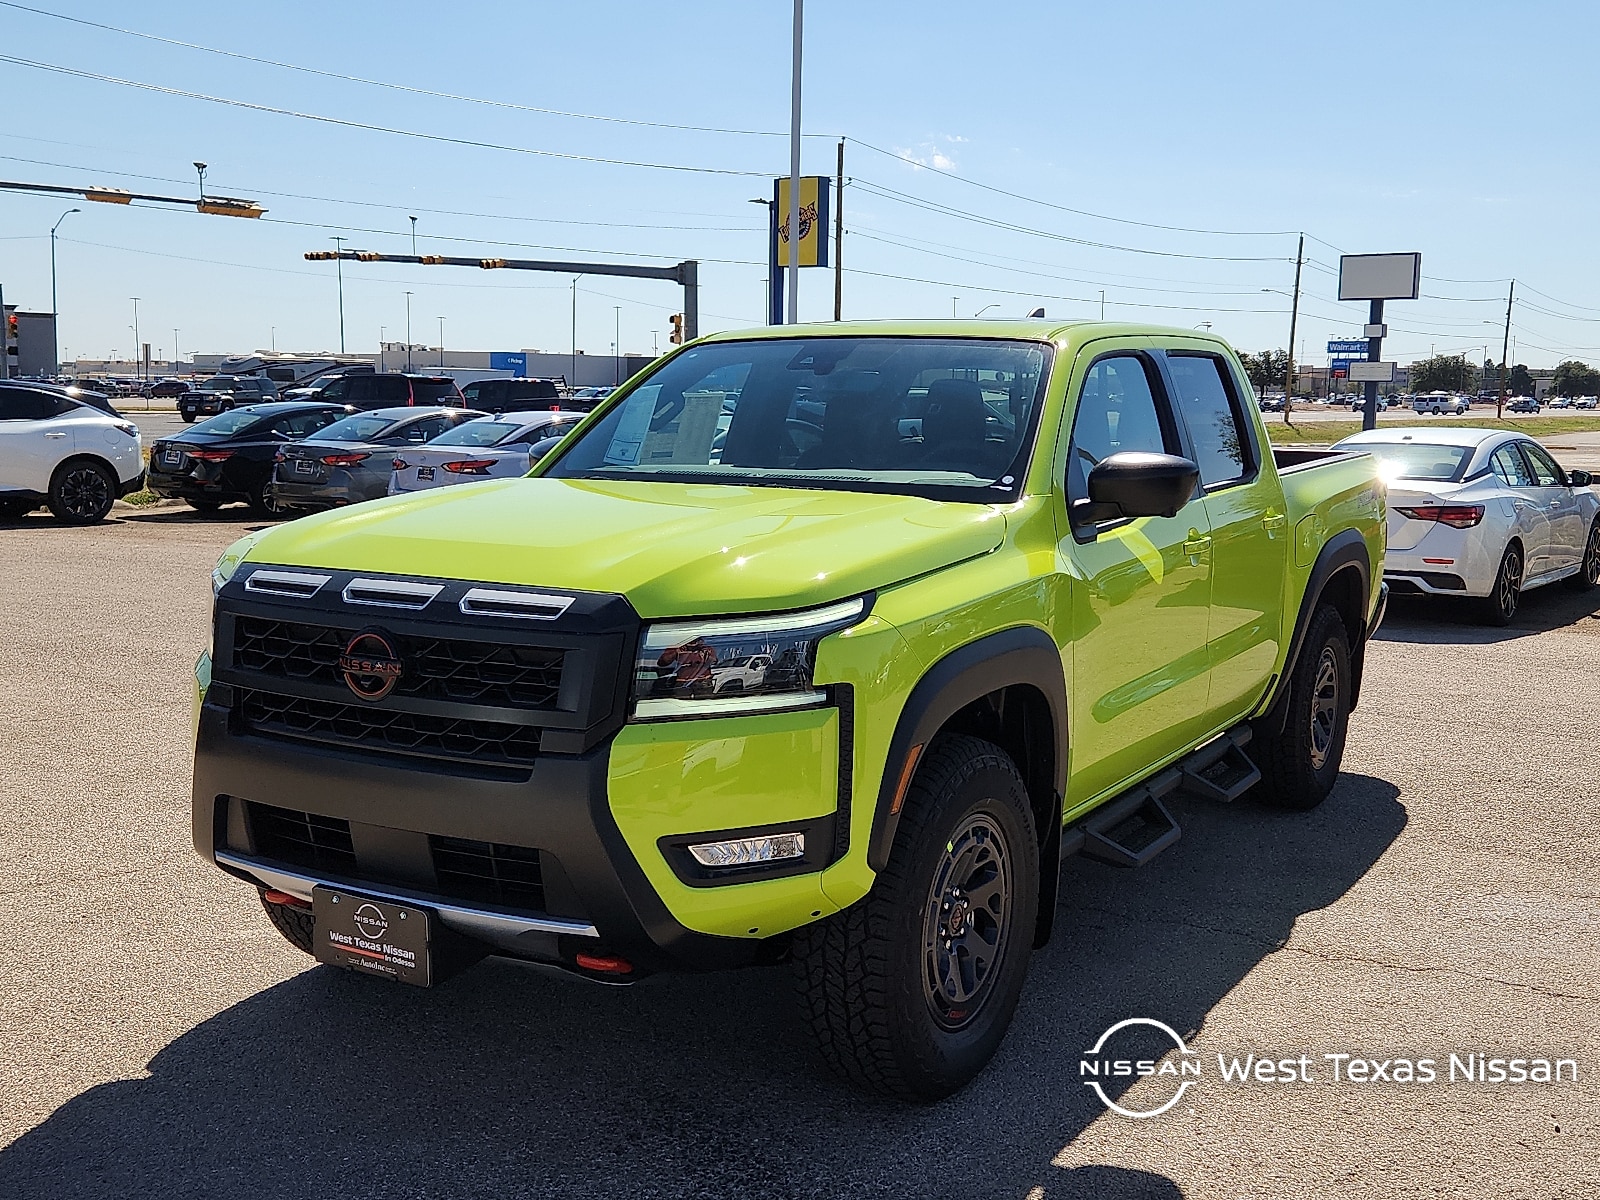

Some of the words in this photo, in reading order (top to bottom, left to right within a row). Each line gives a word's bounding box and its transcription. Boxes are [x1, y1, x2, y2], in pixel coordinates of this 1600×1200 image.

[1329, 343, 1361, 351] Walmart
[339, 658, 400, 674] NISSAN
[353, 915, 388, 928] NISSAN
[329, 930, 353, 945] West
[354, 937, 382, 952] Texas
[383, 943, 415, 960] Nissan
[391, 956, 416, 969] Odessa
